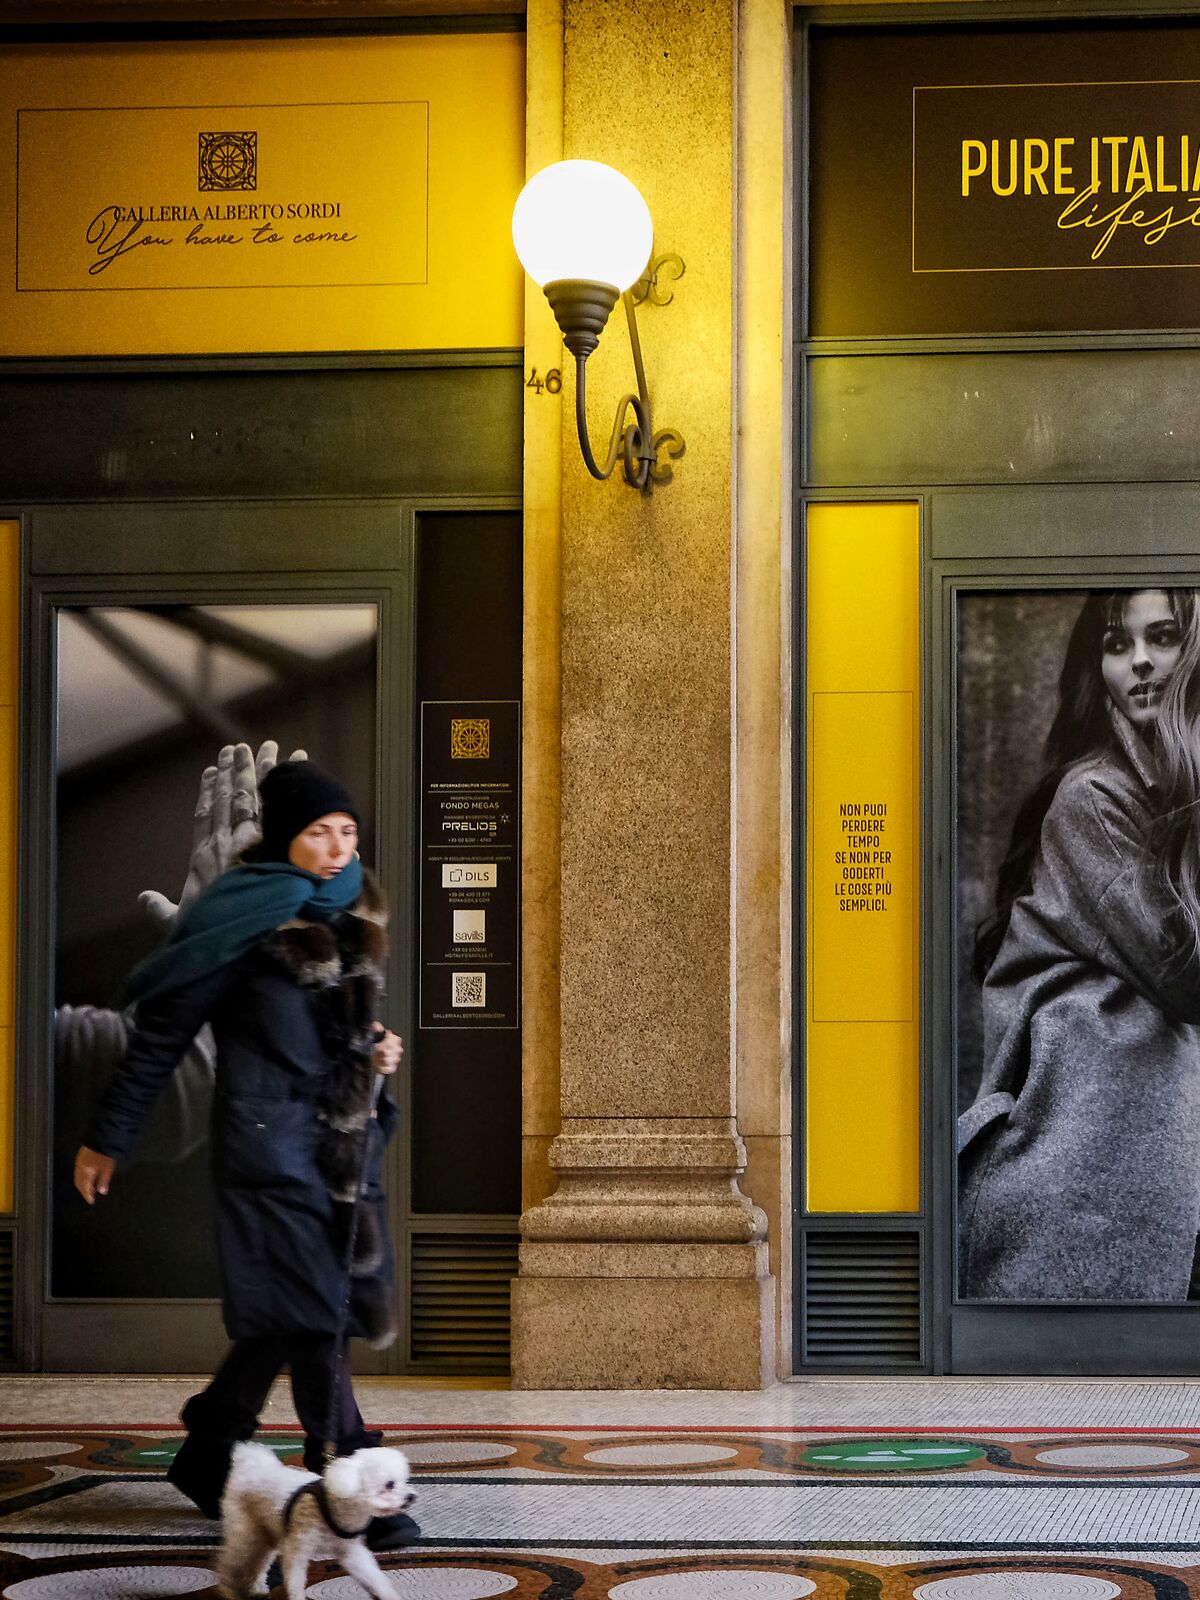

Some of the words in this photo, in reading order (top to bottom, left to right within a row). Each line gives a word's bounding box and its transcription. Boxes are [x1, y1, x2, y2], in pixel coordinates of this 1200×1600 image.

[961, 137, 1076, 197] PURE
[114, 205, 200, 222] GALLERIA
[203, 204, 285, 221] ALBERTO
[286, 202, 341, 219] SORDI
[86, 205, 174, 276] You
[185, 224, 245, 246] have
[251, 222, 285, 244] to
[292, 228, 358, 245] come
[526, 368, 563, 395] 46
[440, 802, 470, 810] FONDO
[471, 801, 500, 810] MEGAS
[839, 803, 861, 817] NON
[863, 803, 887, 816] PUOI
[442, 822, 498, 831] PRELIOS
[842, 819, 885, 832] PERDERE
[847, 835, 880, 848] TEMPO
[835, 851, 847, 864] SE
[849, 851, 870, 864] NON
[873, 851, 892, 864] PER
[465, 872, 490, 881] DILS
[842, 867, 884, 880] GODERTI
[835, 882, 846, 896] LE
[848, 882, 873, 896] COSE
[875, 880, 892, 896] PIÙ
[839, 898, 887, 912] SEMPLICI.
[455, 930, 484, 941] savills
